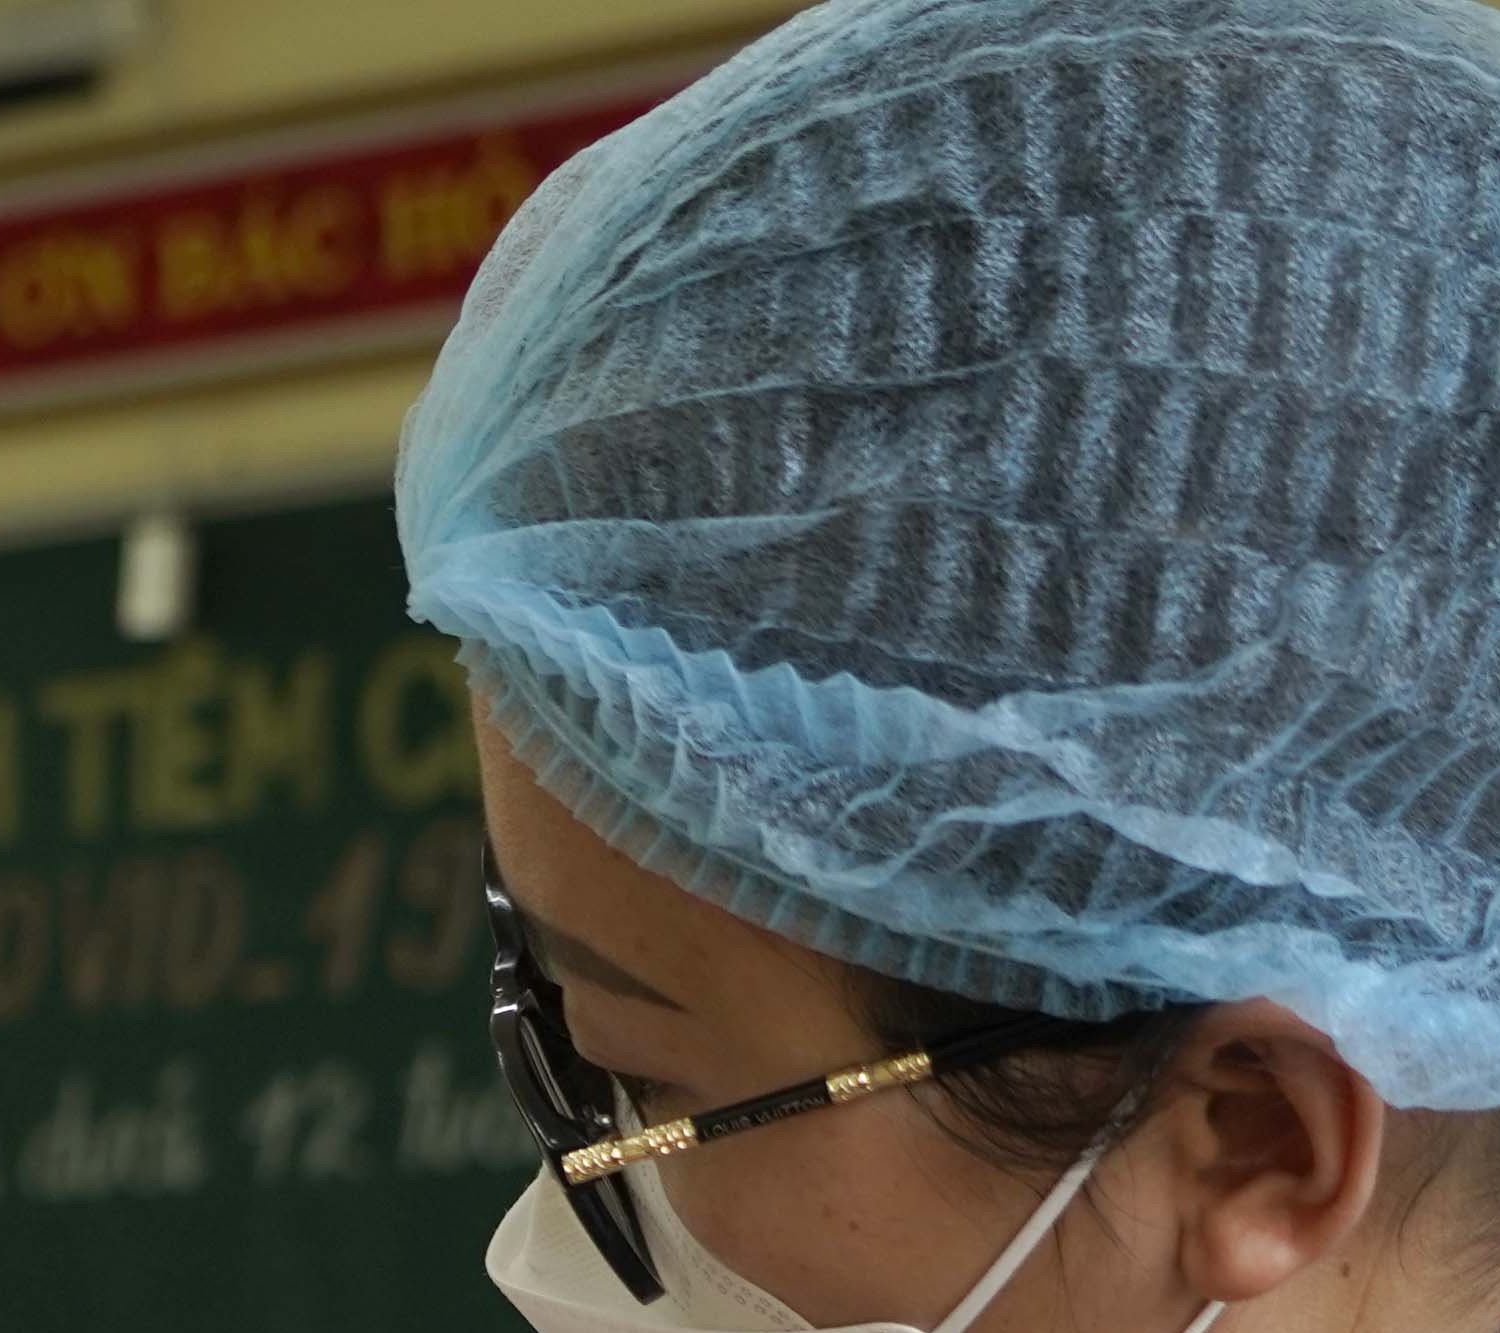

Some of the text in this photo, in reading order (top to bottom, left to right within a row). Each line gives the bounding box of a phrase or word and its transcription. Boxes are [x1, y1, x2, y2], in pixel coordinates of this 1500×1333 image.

[159, 185, 368, 315] BÁC
[45, 641, 328, 832] TIÊM
[243, 1065, 374, 1176] 12
[703, 1095, 826, 1138] LOUIS VUITTON
